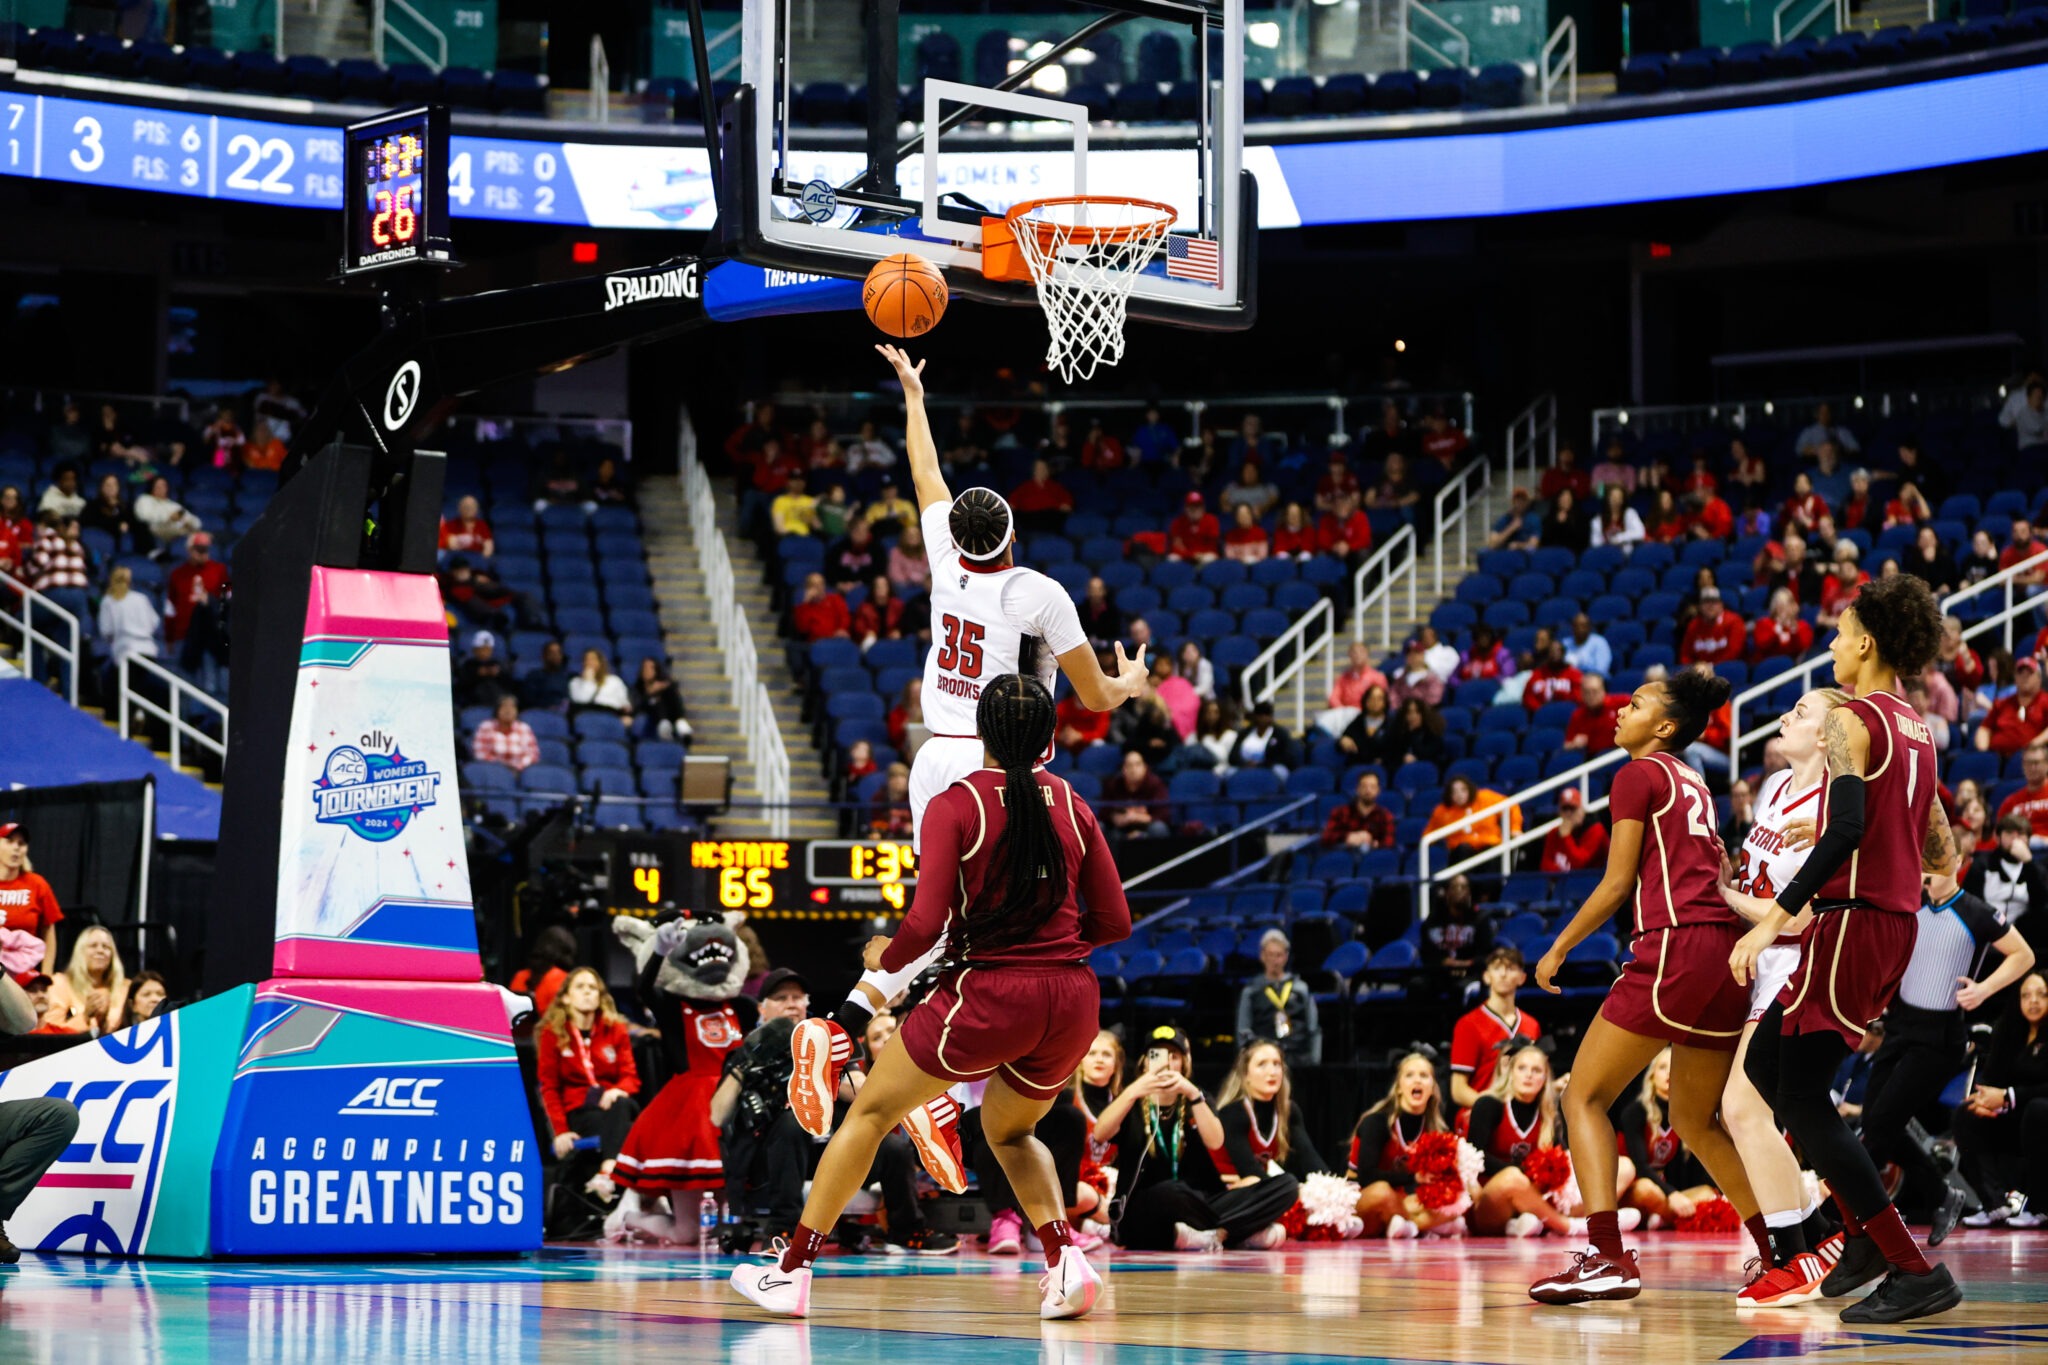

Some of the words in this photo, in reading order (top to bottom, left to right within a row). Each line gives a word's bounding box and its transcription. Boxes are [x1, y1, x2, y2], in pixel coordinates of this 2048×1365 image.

[7, 103, 25, 131] 7
[8, 138, 20, 166] 1
[69, 115, 105, 173] 3
[180, 123, 201, 153] 6
[179, 157, 200, 188] 3
[225, 134, 295, 195] 22
[534, 152, 557, 182] 0
[534, 186, 555, 215] 2
[806, 193, 835, 205] ACC
[373, 184, 416, 246] 26
[359, 246, 417, 267] DAKTRONICS
[604, 263, 699, 311] SPALDING
[937, 613, 985, 679] 35
[937, 674, 980, 700] BROOKS
[360, 730, 394, 753] ally
[334, 763, 363, 774] ACC
[373, 763, 424, 780] WOMEN'S
[1907, 747, 1919, 809] 1
[313, 772, 440, 819] TOURNAMENT
[365, 818, 388, 828] 2024
[1749, 825, 1784, 857] STATE
[633, 867, 661, 903] 4
[719, 866, 774, 908] 65
[881, 882, 905, 909] 4
[346, 1077, 444, 1108] ACC
[252, 1136, 525, 1163] ACCOMPLISH
[250, 1169, 524, 1225] GREATNESS
